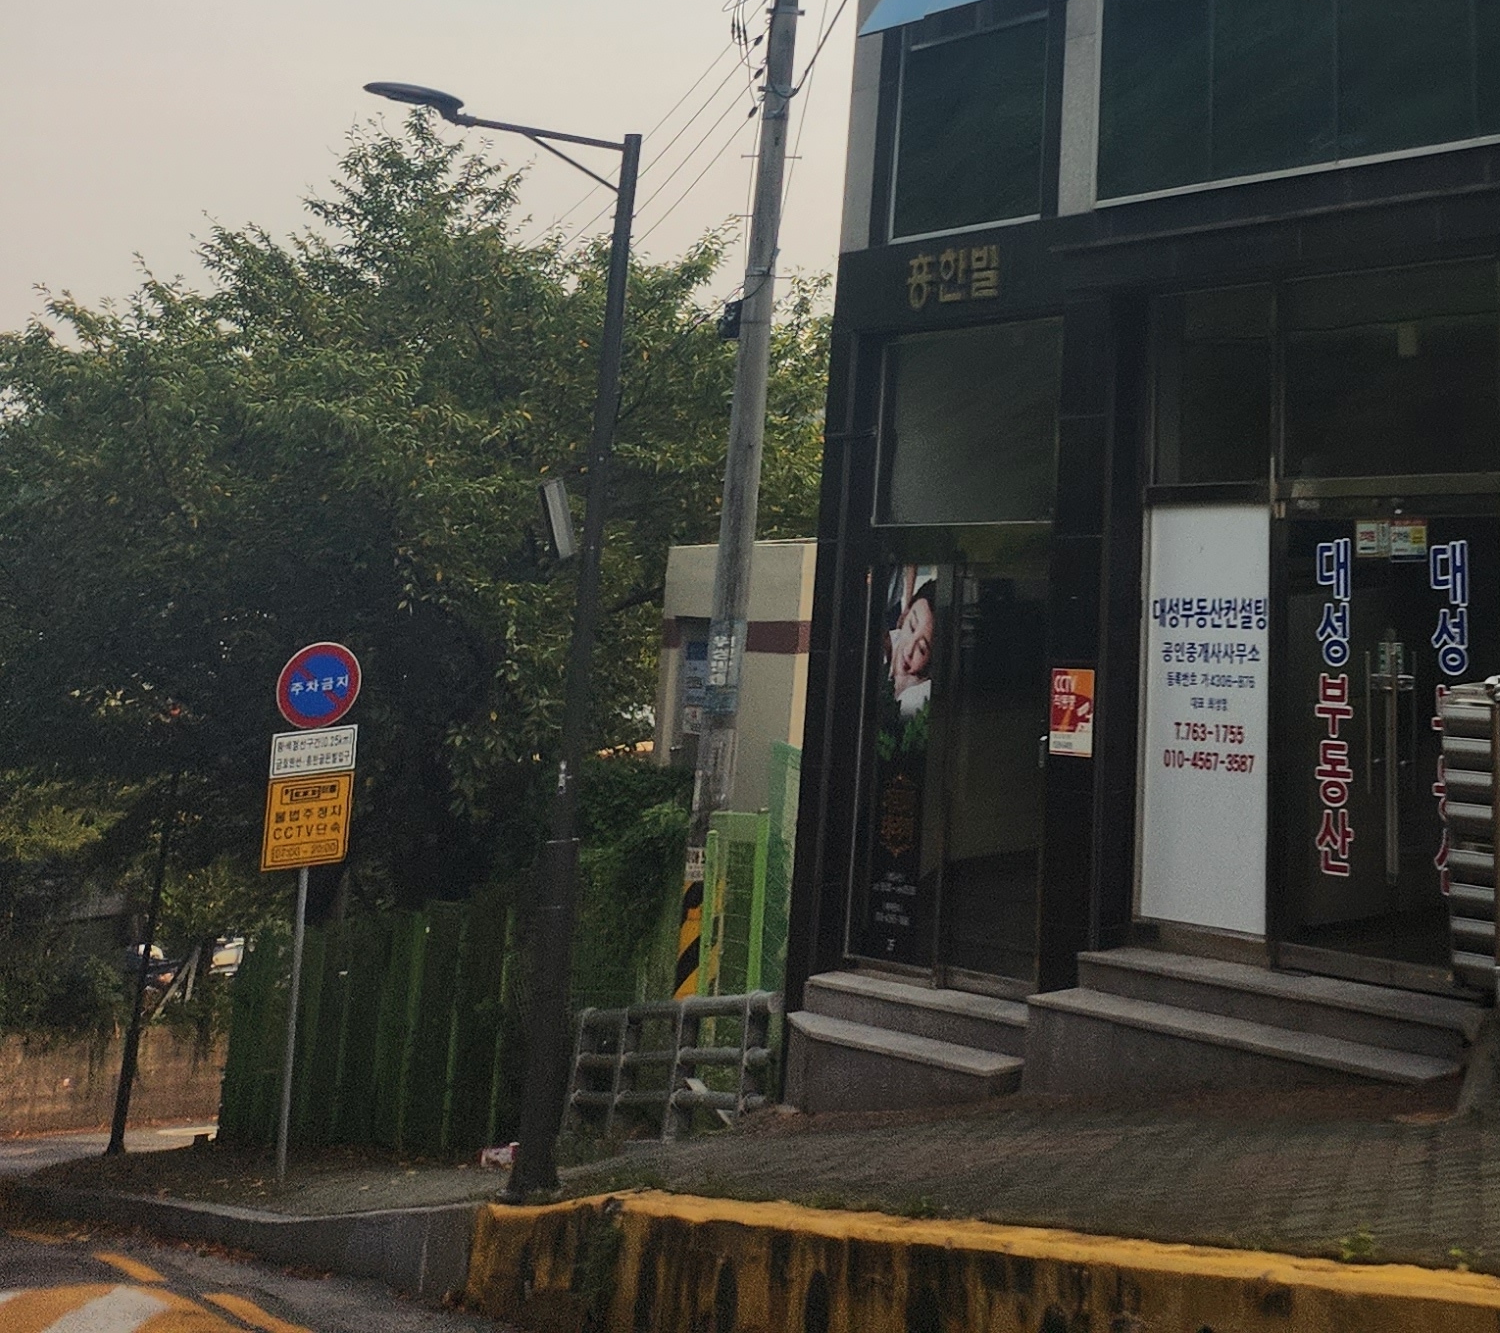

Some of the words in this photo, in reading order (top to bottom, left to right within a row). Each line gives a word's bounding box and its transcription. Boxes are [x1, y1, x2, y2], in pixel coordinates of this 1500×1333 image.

[1152, 597, 1268, 631] 대성부동산컨설팅
[1161, 641, 1261, 665] 공인중개사사무소
[290, 674, 349, 695] 주차금지
[1174, 721, 1245, 745] T.763-1755
[1163, 748, 1255, 774] 010-4567-3587
